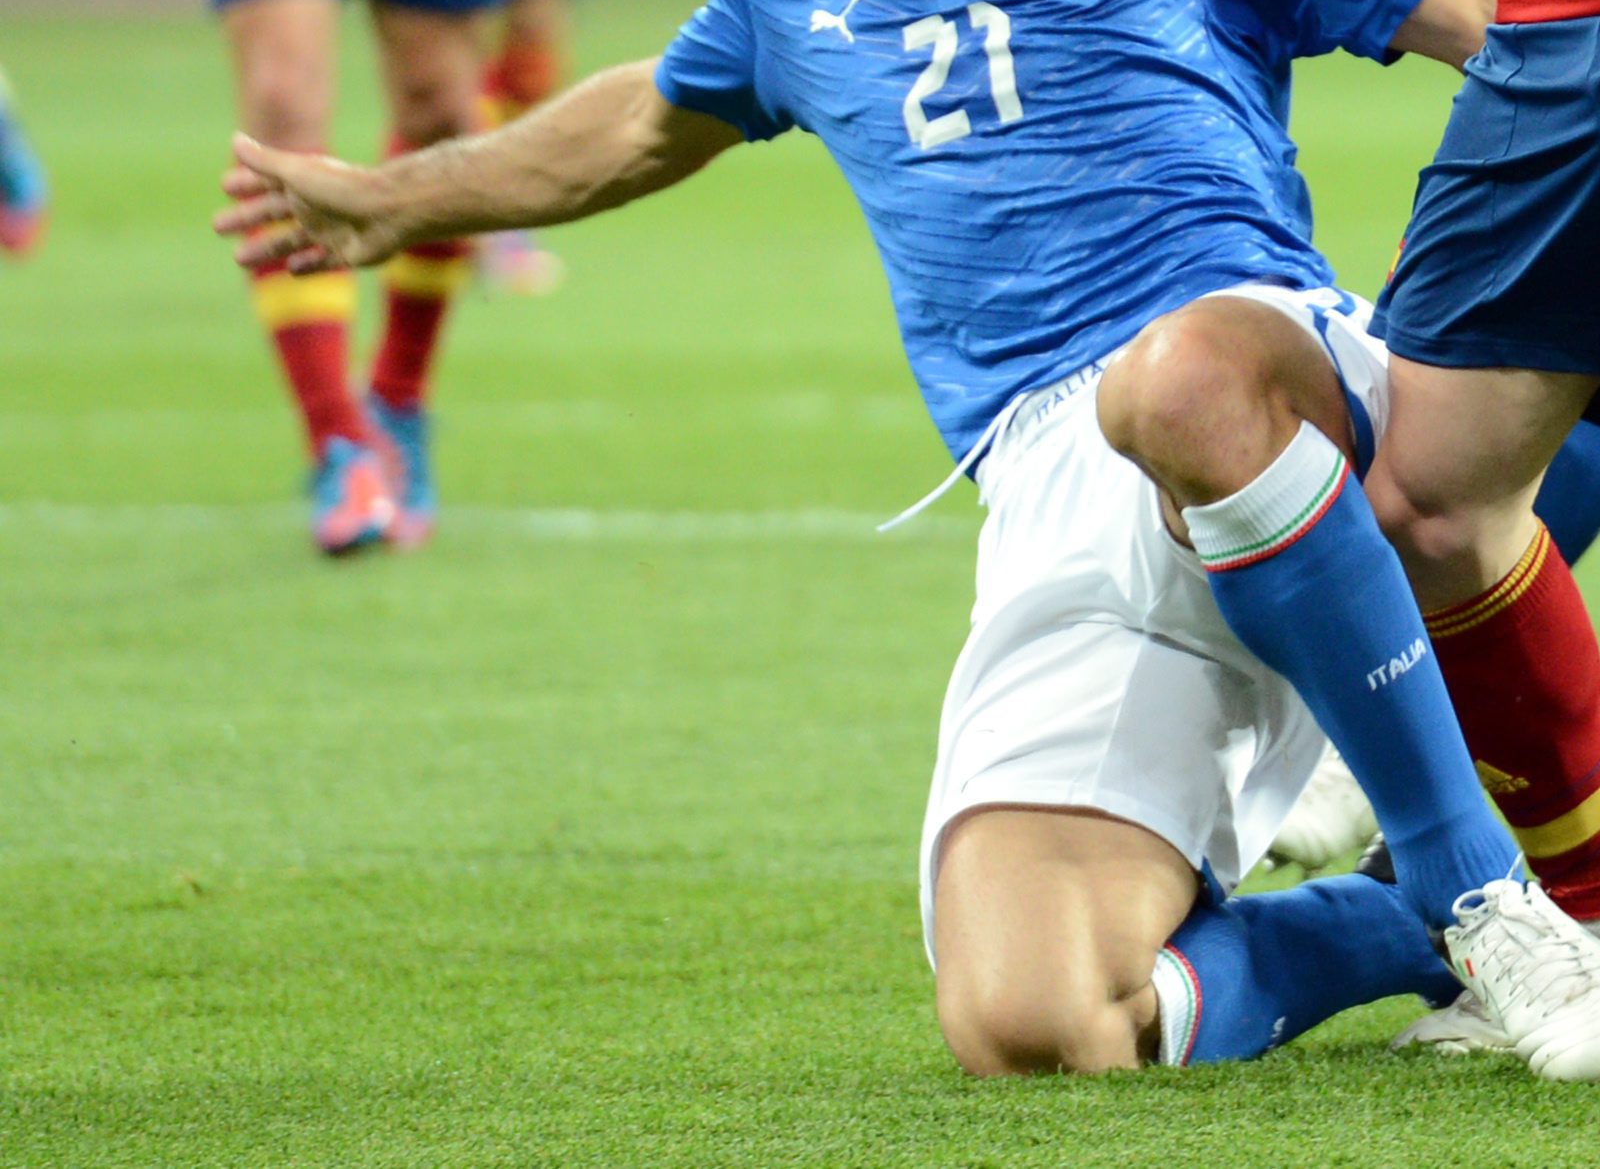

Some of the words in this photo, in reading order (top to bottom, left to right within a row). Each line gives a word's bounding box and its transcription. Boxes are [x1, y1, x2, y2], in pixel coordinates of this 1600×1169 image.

[902, 1, 1024, 150] 21
[1036, 361, 1104, 425] ITALIA
[1367, 638, 1427, 691] ITALIA
